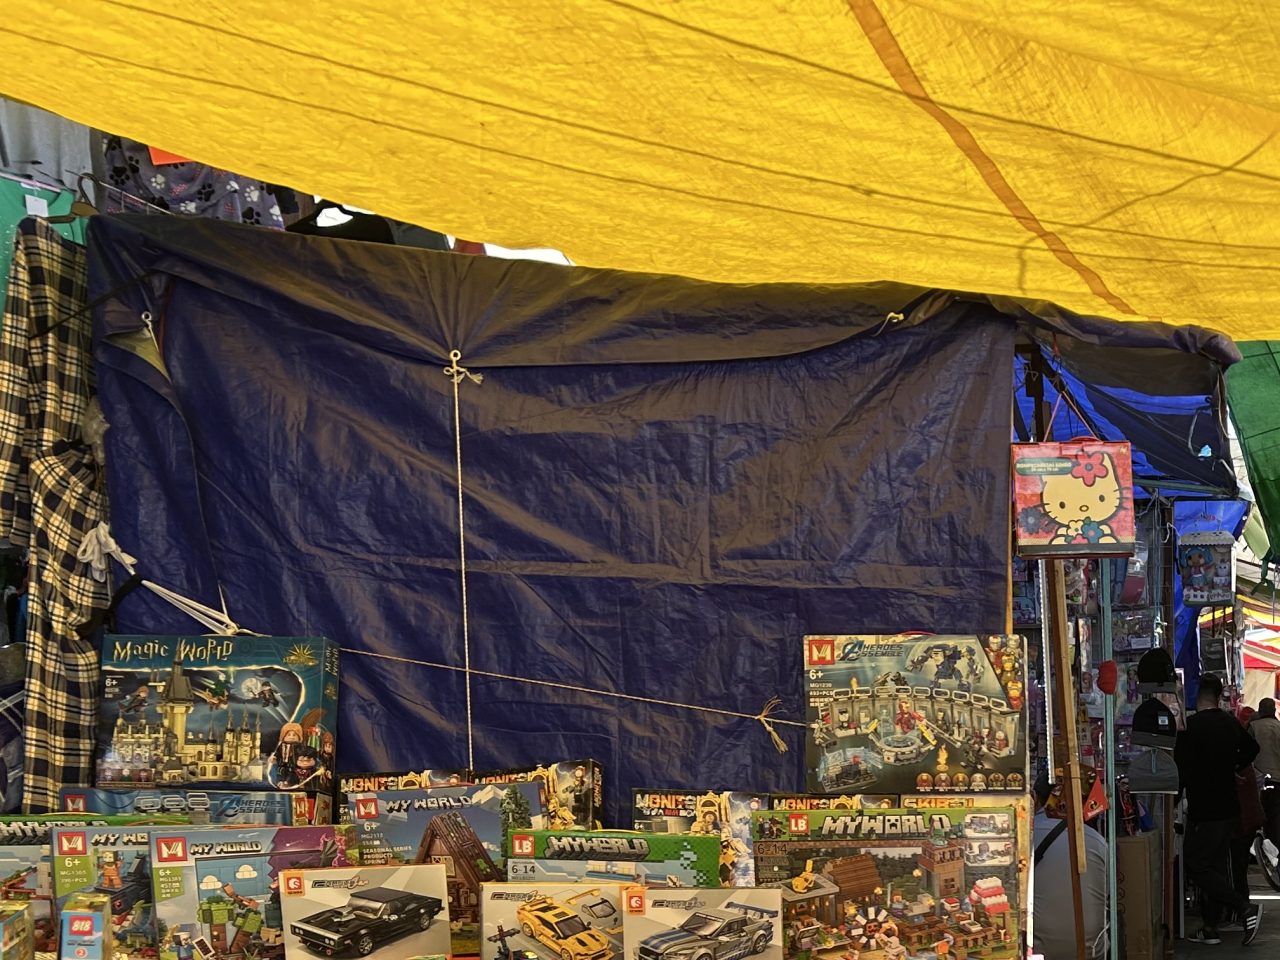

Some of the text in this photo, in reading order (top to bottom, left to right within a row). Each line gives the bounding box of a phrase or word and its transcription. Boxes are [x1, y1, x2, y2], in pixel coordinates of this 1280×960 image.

[114, 639, 169, 663] Magic
[863, 644, 904, 652] HEROES
[810, 669, 824, 680] 6+
[385, 796, 473, 813] MY WORLD
[364, 821, 377, 832] 6+
[791, 818, 807, 831] LB
[215, 841, 262, 854] WORLD
[514, 839, 532, 854] LB
[363, 852, 393, 860] PRODUCTS
[65, 857, 81, 868] 6+
[159, 869, 172, 877] 6+
